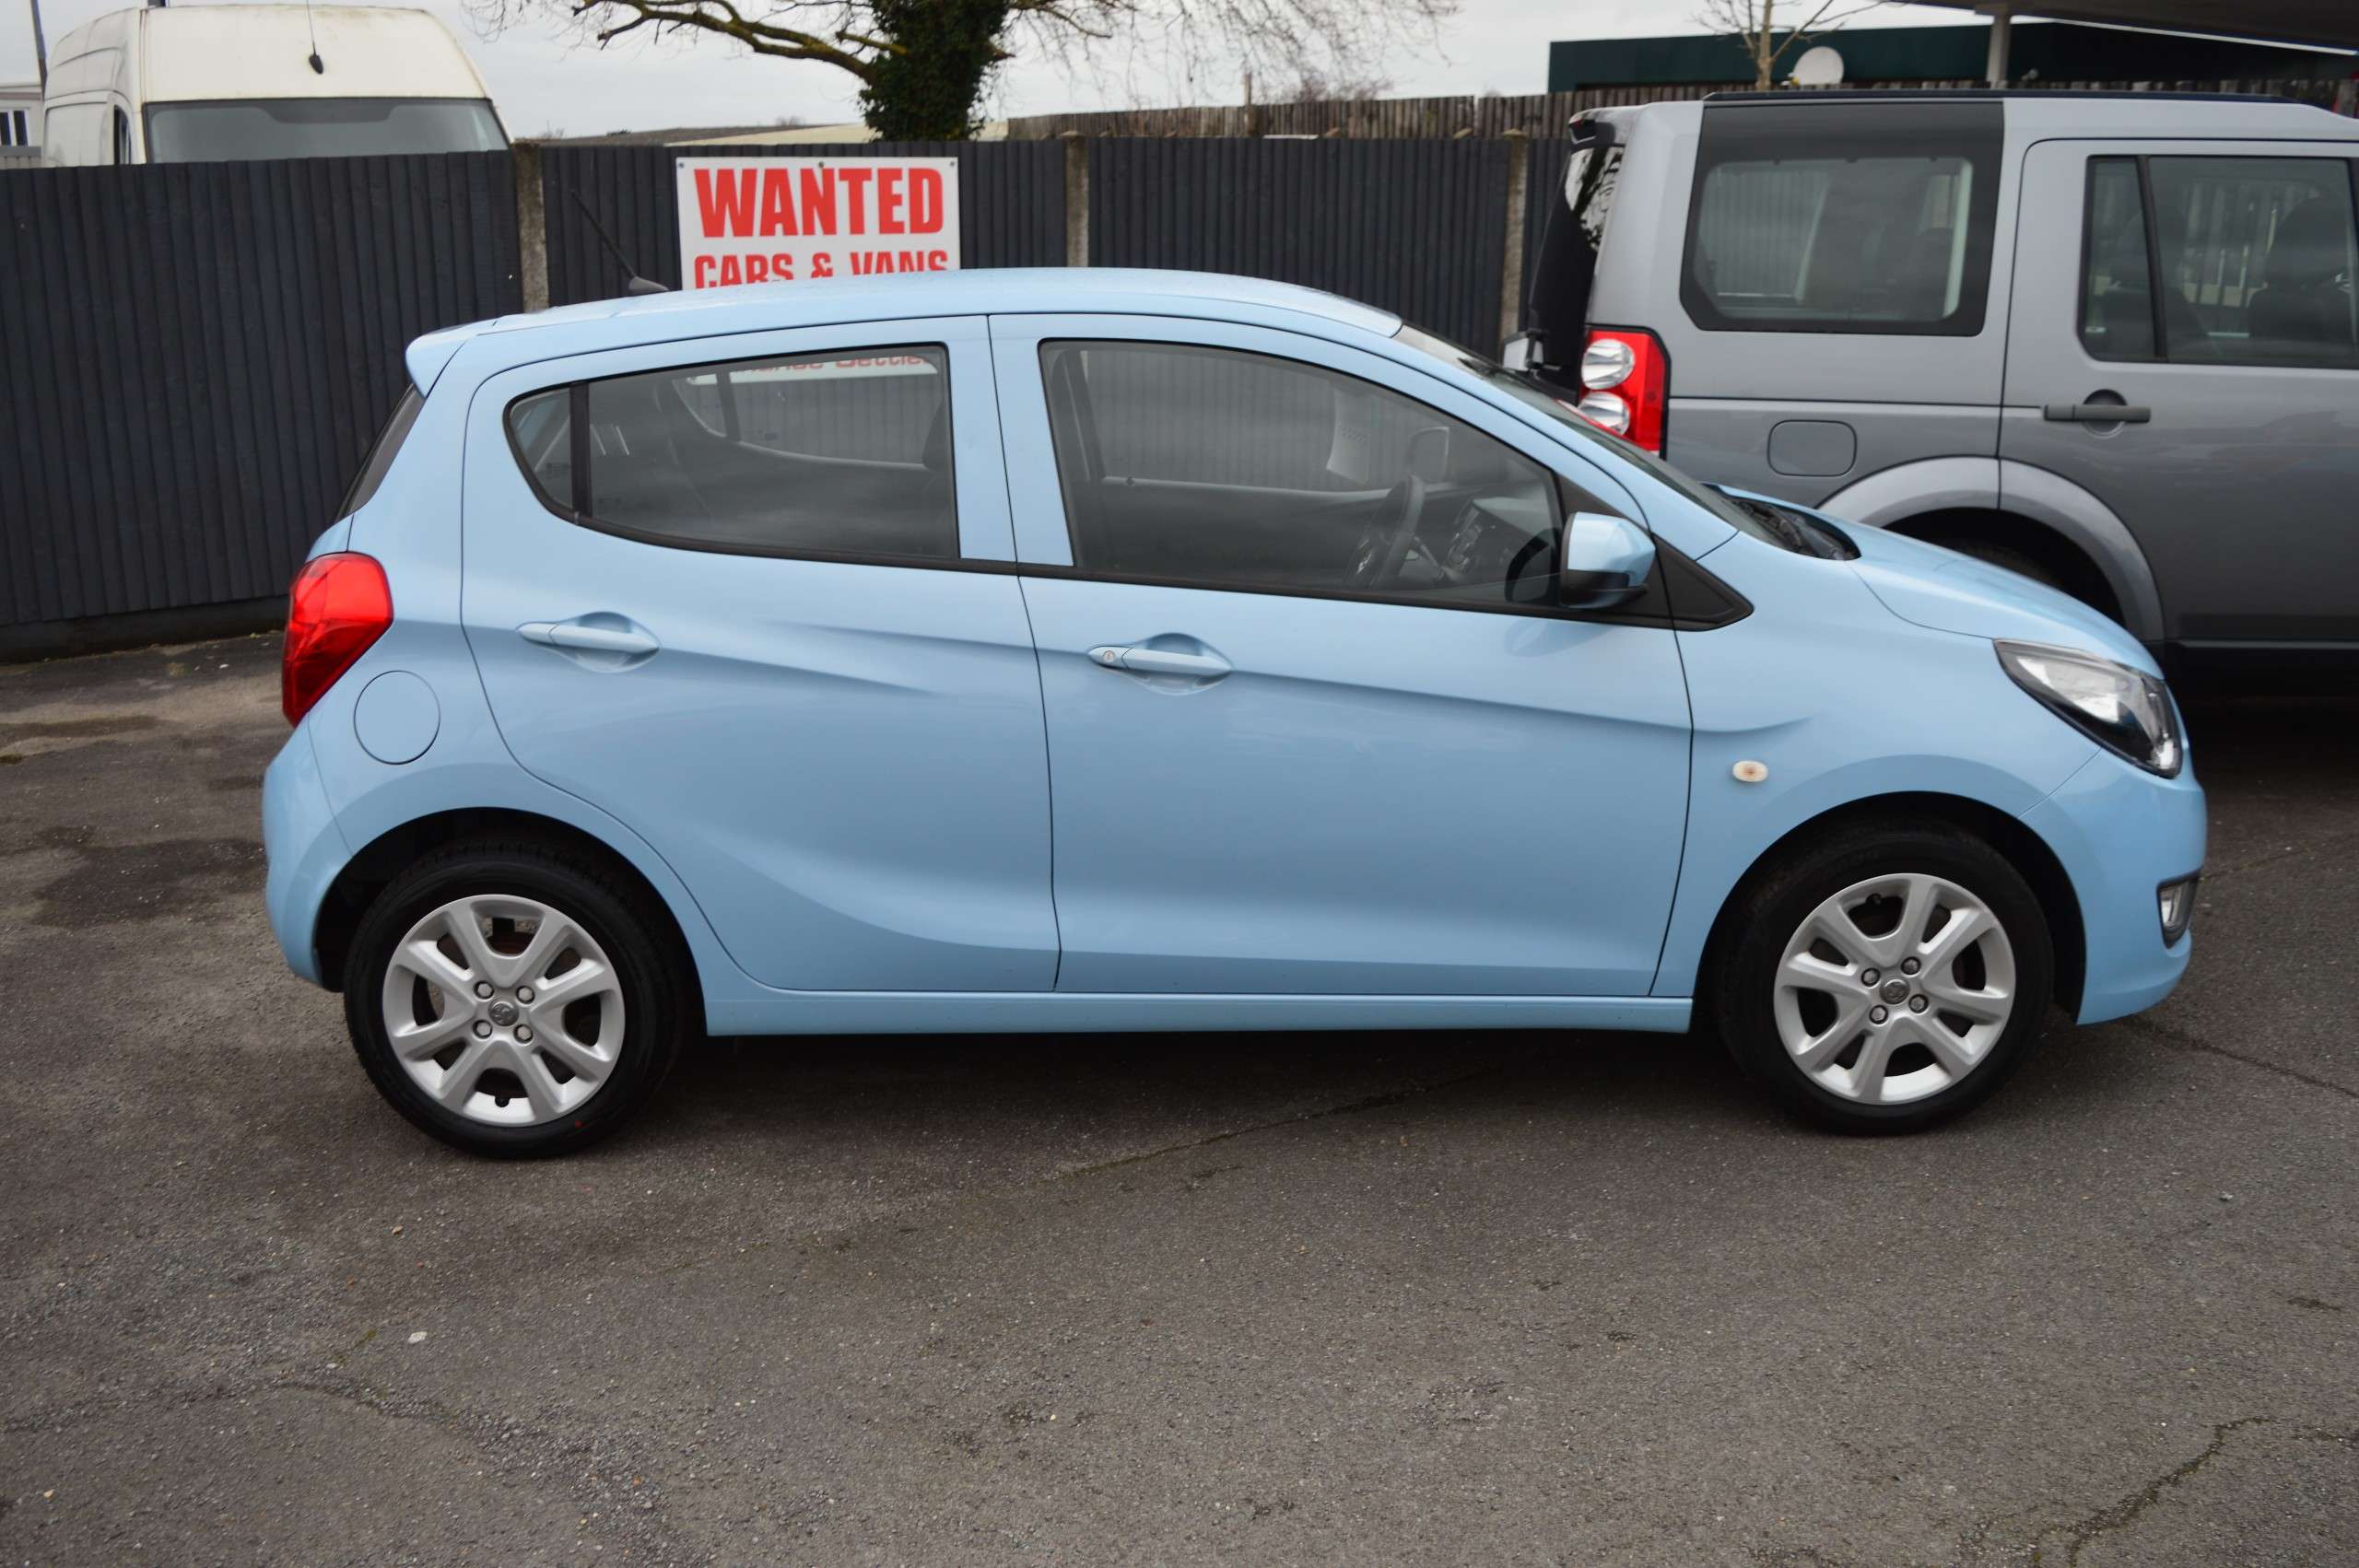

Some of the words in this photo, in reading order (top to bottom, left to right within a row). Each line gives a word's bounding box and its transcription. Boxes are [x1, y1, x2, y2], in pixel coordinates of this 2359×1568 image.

[694, 168, 944, 238] WANTED
[694, 253, 794, 289] CARS
[811, 252, 834, 278] &
